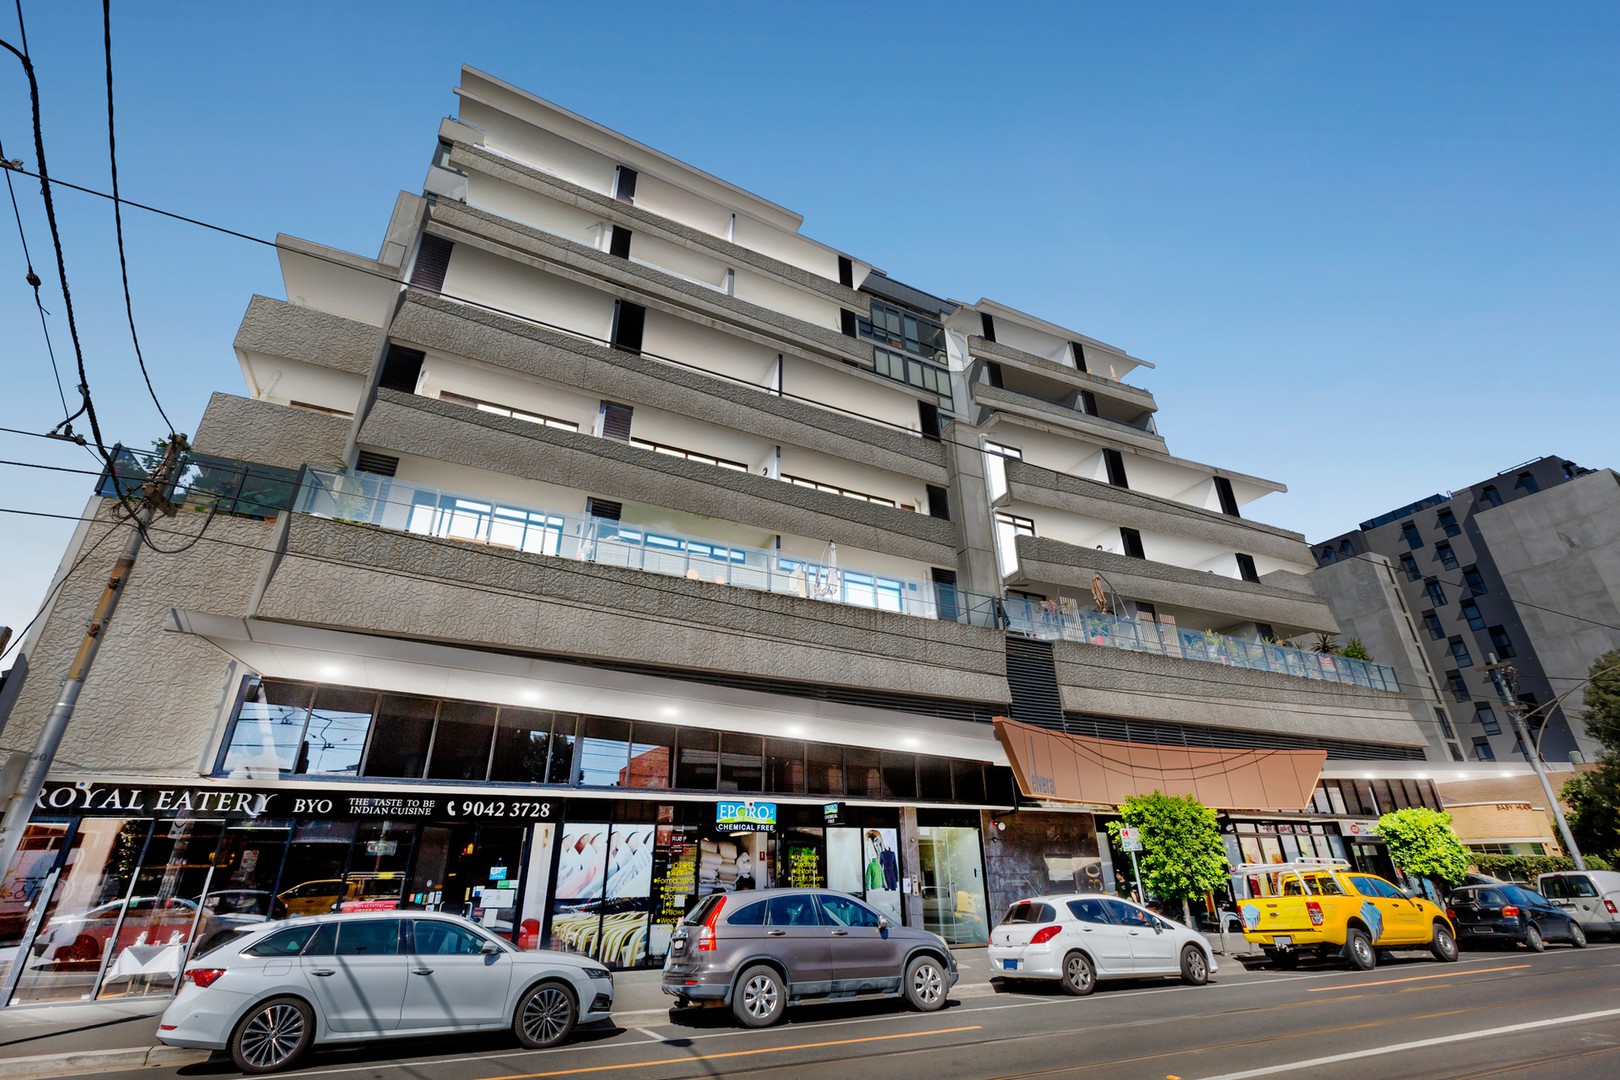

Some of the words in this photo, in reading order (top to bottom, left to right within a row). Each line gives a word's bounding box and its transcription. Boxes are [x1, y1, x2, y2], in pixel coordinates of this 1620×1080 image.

[153, 789, 277, 817] EATERY
[292, 798, 334, 814] BYO
[349, 798, 370, 806] THE
[374, 798, 404, 808] TASTE
[407, 799, 420, 808] TO
[423, 799, 436, 808] BE
[349, 806, 389, 815] INDIAN
[391, 806, 432, 816] CUISINE
[462, 801, 505, 817] 9042
[509, 802, 551, 817] 3728
[719, 804, 770, 820] EPORO
[717, 823, 756, 832] CHEMICAL
